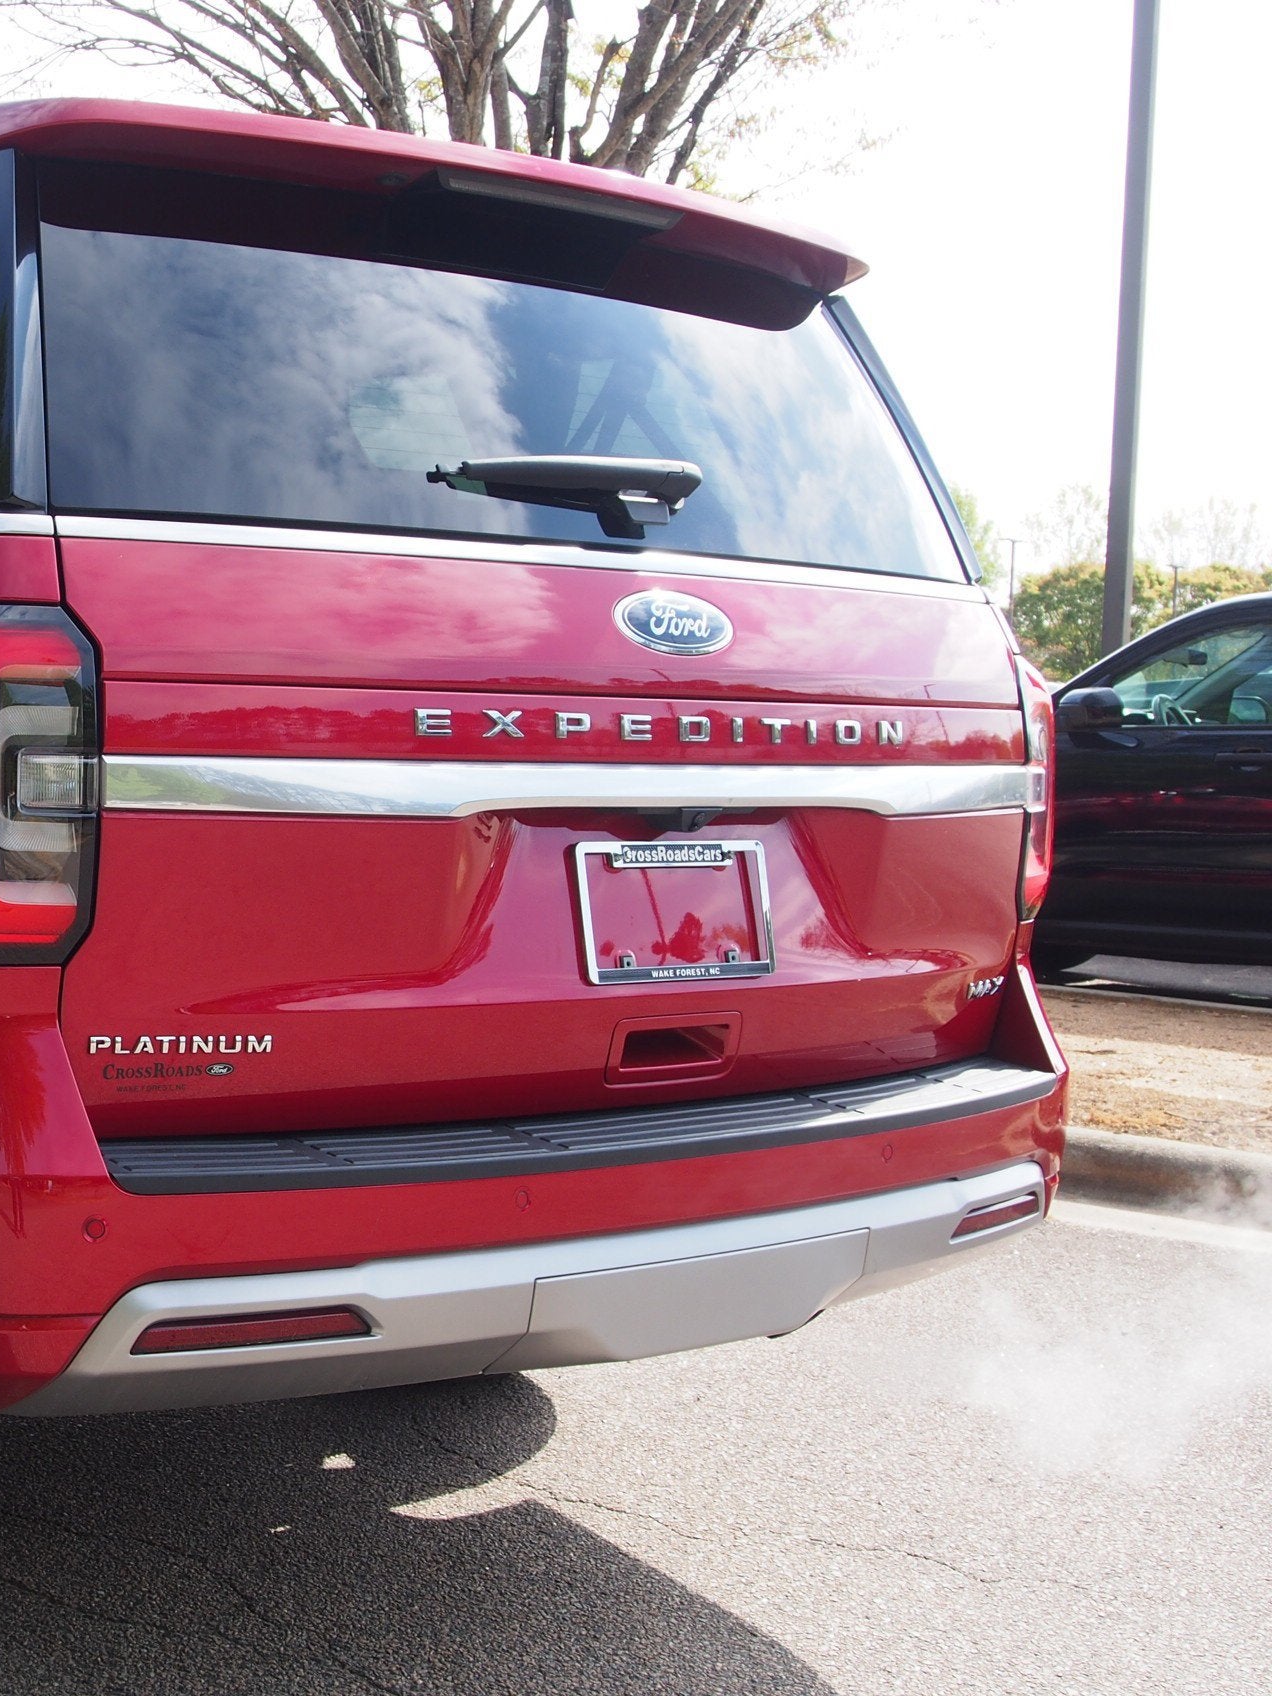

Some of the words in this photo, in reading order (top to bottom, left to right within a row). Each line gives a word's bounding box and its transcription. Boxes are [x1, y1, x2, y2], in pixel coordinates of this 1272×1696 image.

[649, 599, 711, 639] Ford
[413, 707, 904, 747] EXPEDITION
[622, 845, 723, 863] CrossRoadsCars
[651, 969, 675, 978] WAKE
[676, 968, 708, 977] FOREST,
[709, 967, 721, 975] NC
[88, 1034, 273, 1054] PLATINUM
